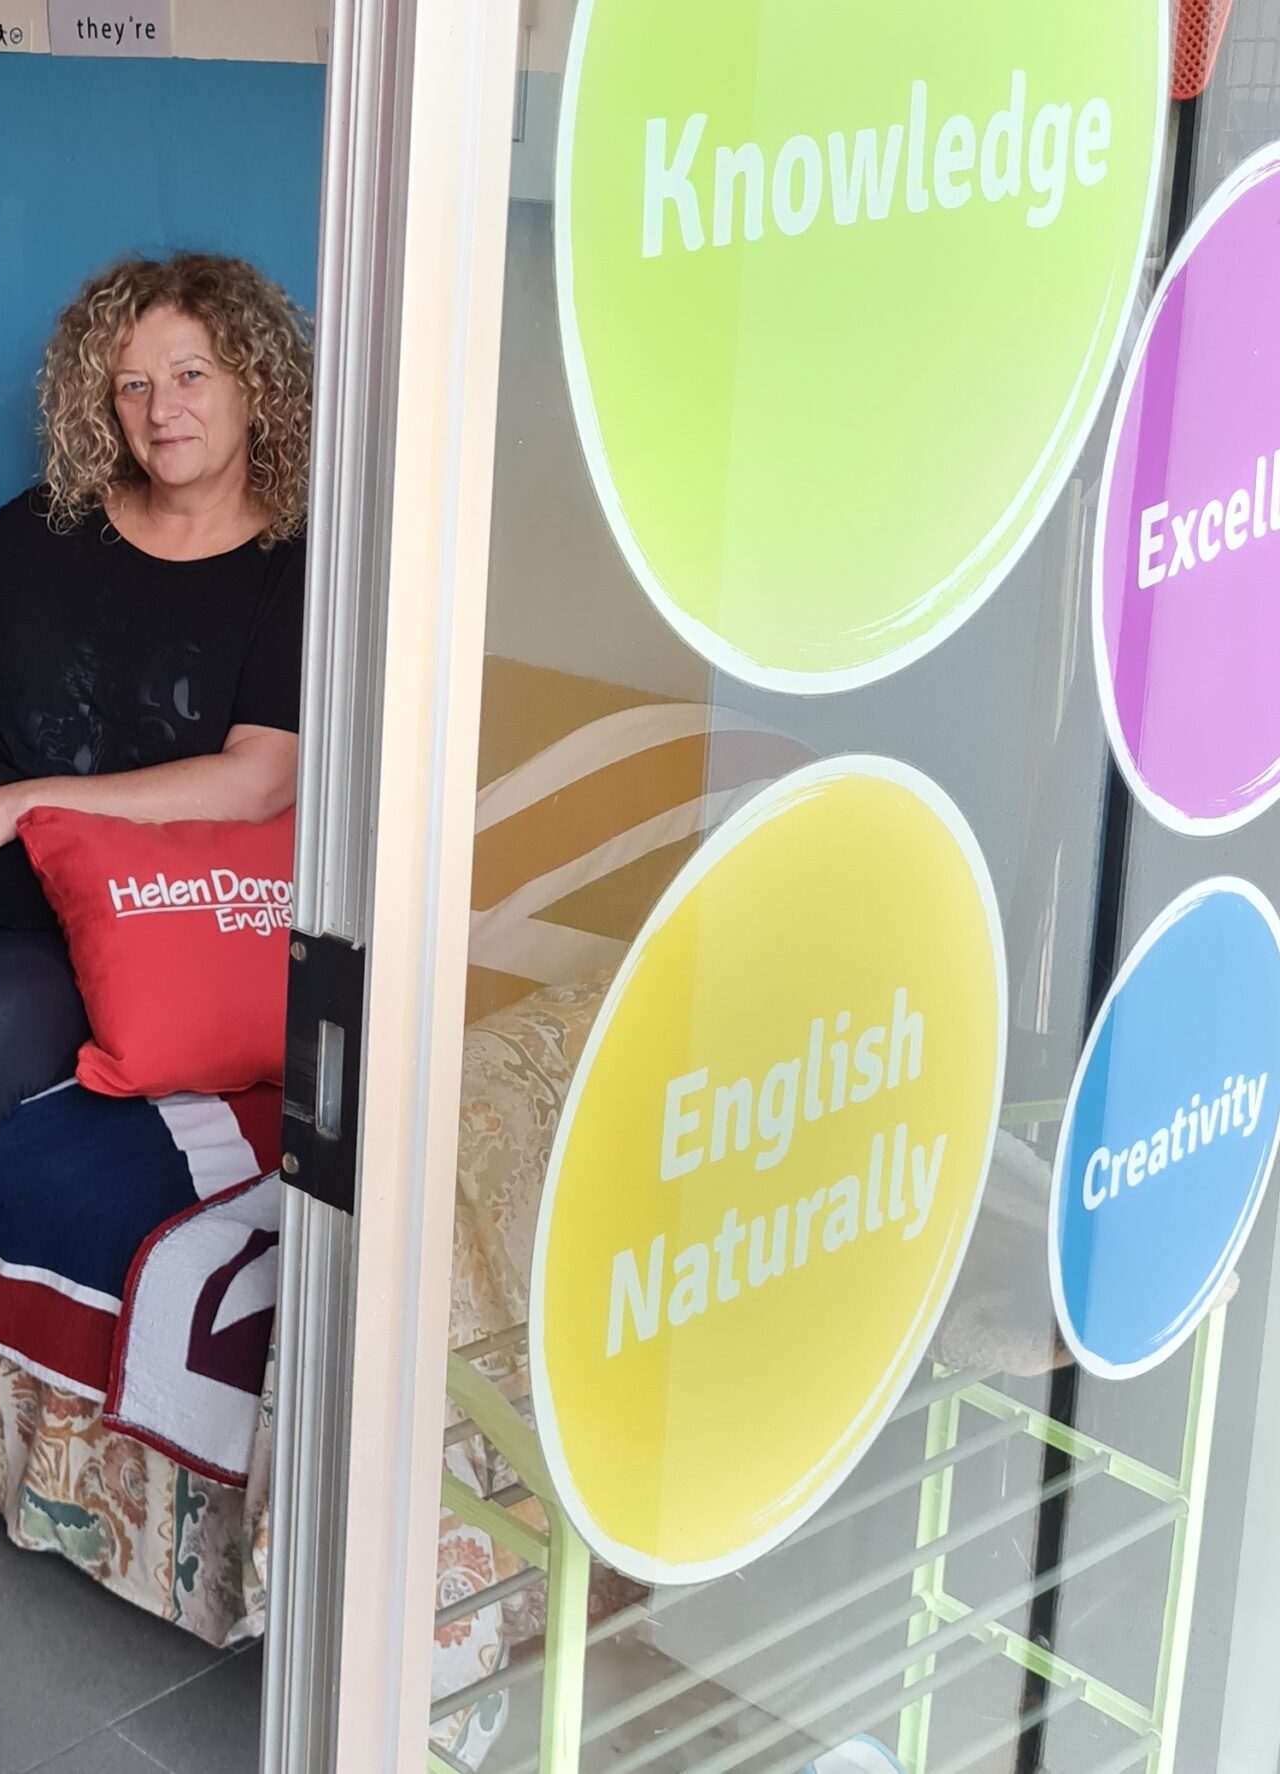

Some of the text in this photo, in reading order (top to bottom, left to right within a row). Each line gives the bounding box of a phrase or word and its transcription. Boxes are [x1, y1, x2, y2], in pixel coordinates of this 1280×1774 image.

[76, 15, 156, 46] they're
[642, 69, 1112, 259] Knowledge
[108, 872, 211, 911] Helen
[660, 987, 925, 1182] English
[1082, 1072, 1268, 1211] Creativity
[605, 1123, 948, 1359] Naturally
